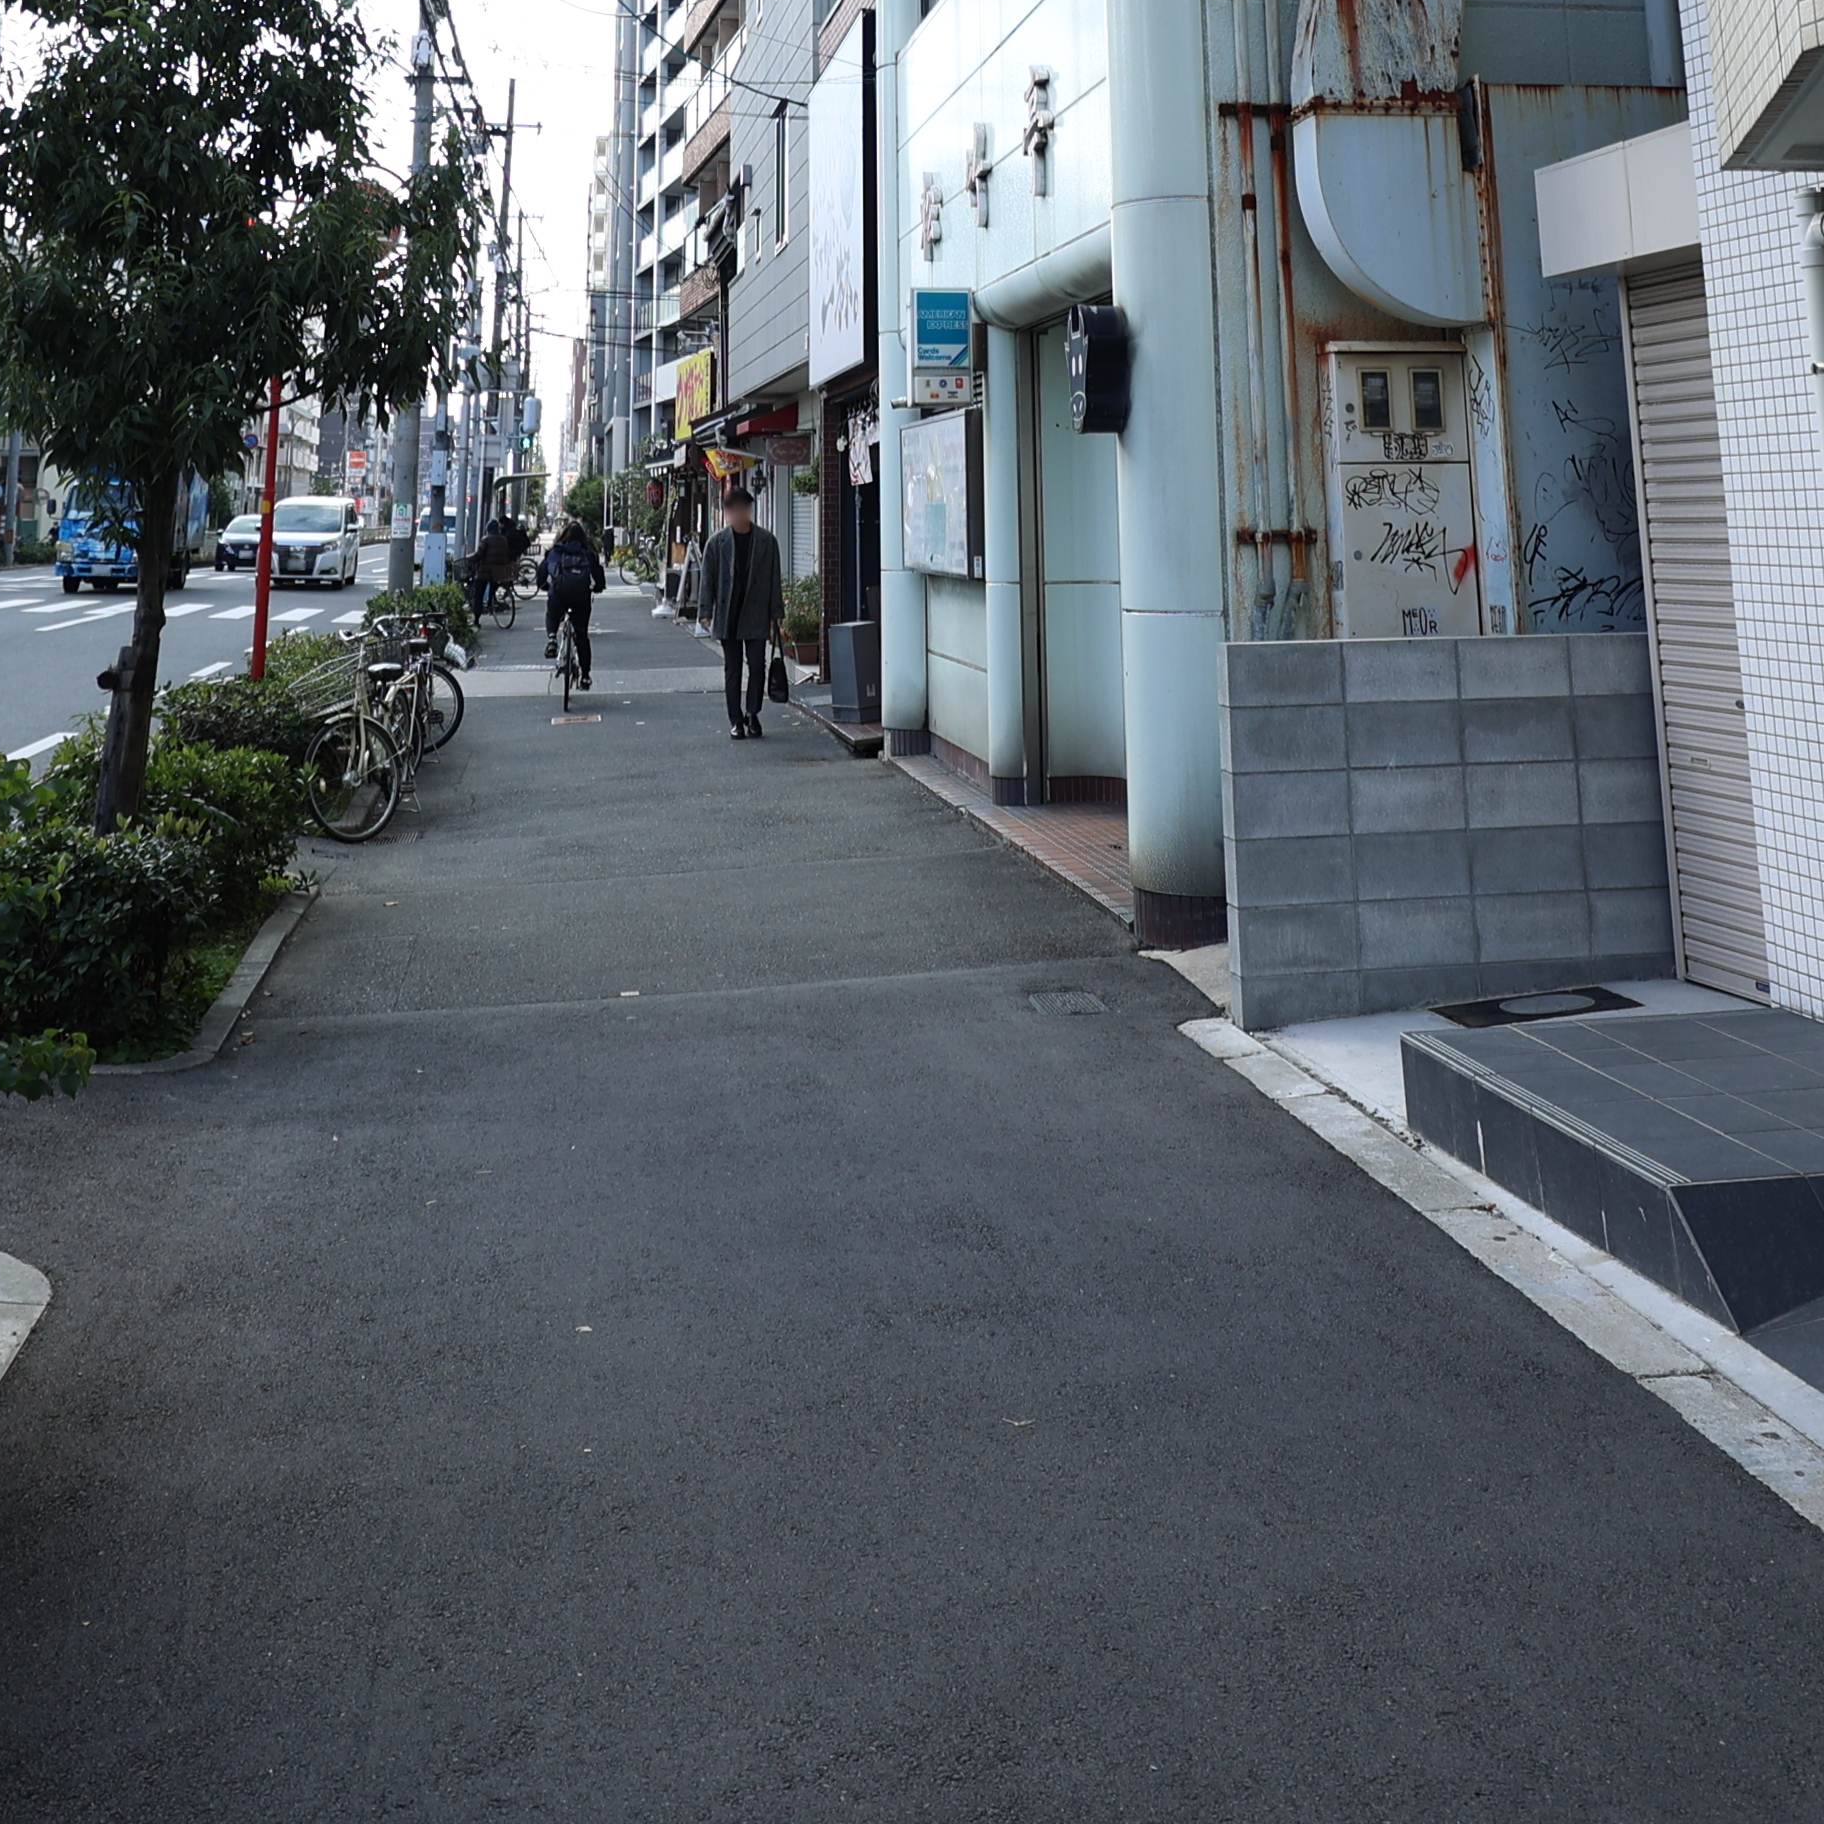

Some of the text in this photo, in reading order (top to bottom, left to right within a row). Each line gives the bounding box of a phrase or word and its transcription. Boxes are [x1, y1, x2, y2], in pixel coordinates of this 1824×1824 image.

[917, 309, 965, 320] AMERICAN
[927, 320, 969, 330] EXPRESS
[918, 347, 939, 355] Cards
